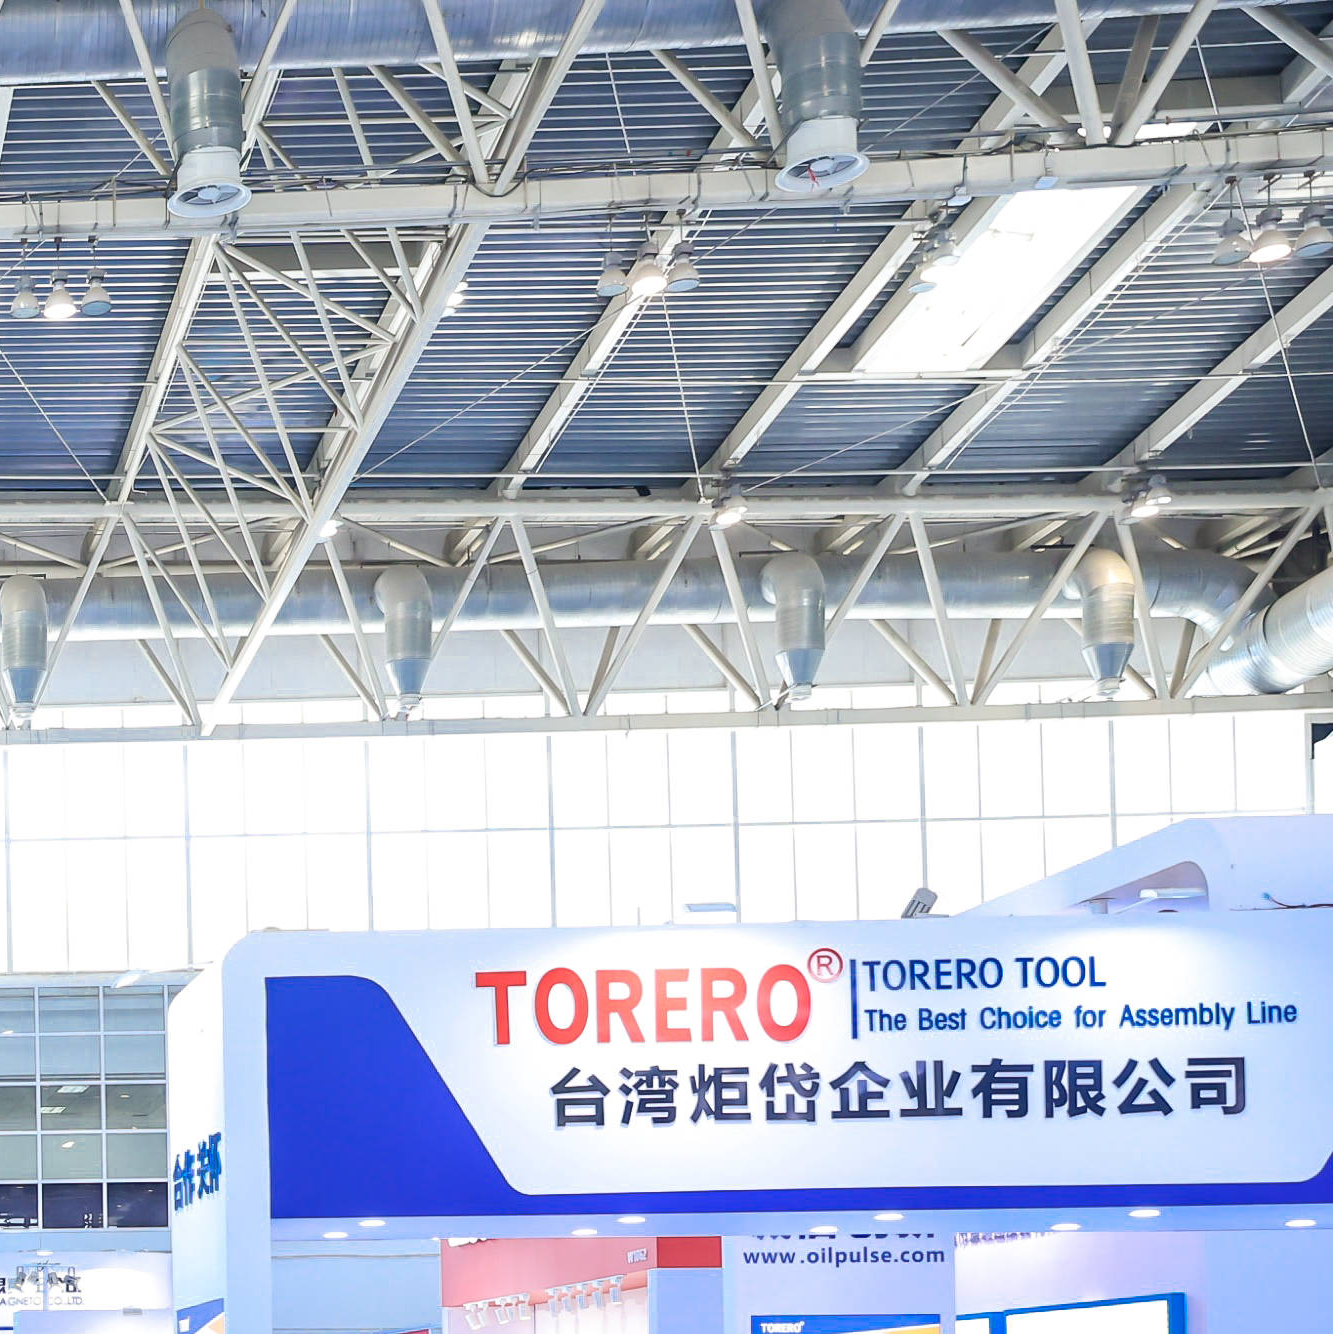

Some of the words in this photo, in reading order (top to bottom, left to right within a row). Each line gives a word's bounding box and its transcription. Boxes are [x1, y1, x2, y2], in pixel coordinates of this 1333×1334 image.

[862, 957, 1004, 992] TORERO
[1015, 956, 1107, 988] TOOL
[475, 963, 812, 1046] TORERO
[864, 1008, 907, 1032] The
[918, 1008, 967, 1031] Best
[980, 1005, 1062, 1030] Choice
[1074, 1005, 1106, 1028] for
[1119, 1002, 1235, 1031] Assembly
[1246, 1001, 1298, 1025] Line
[549, 1057, 1247, 1127] 台湾炬岱企业有限公司
[743, 1247, 946, 1267] www.oilpulse.com
